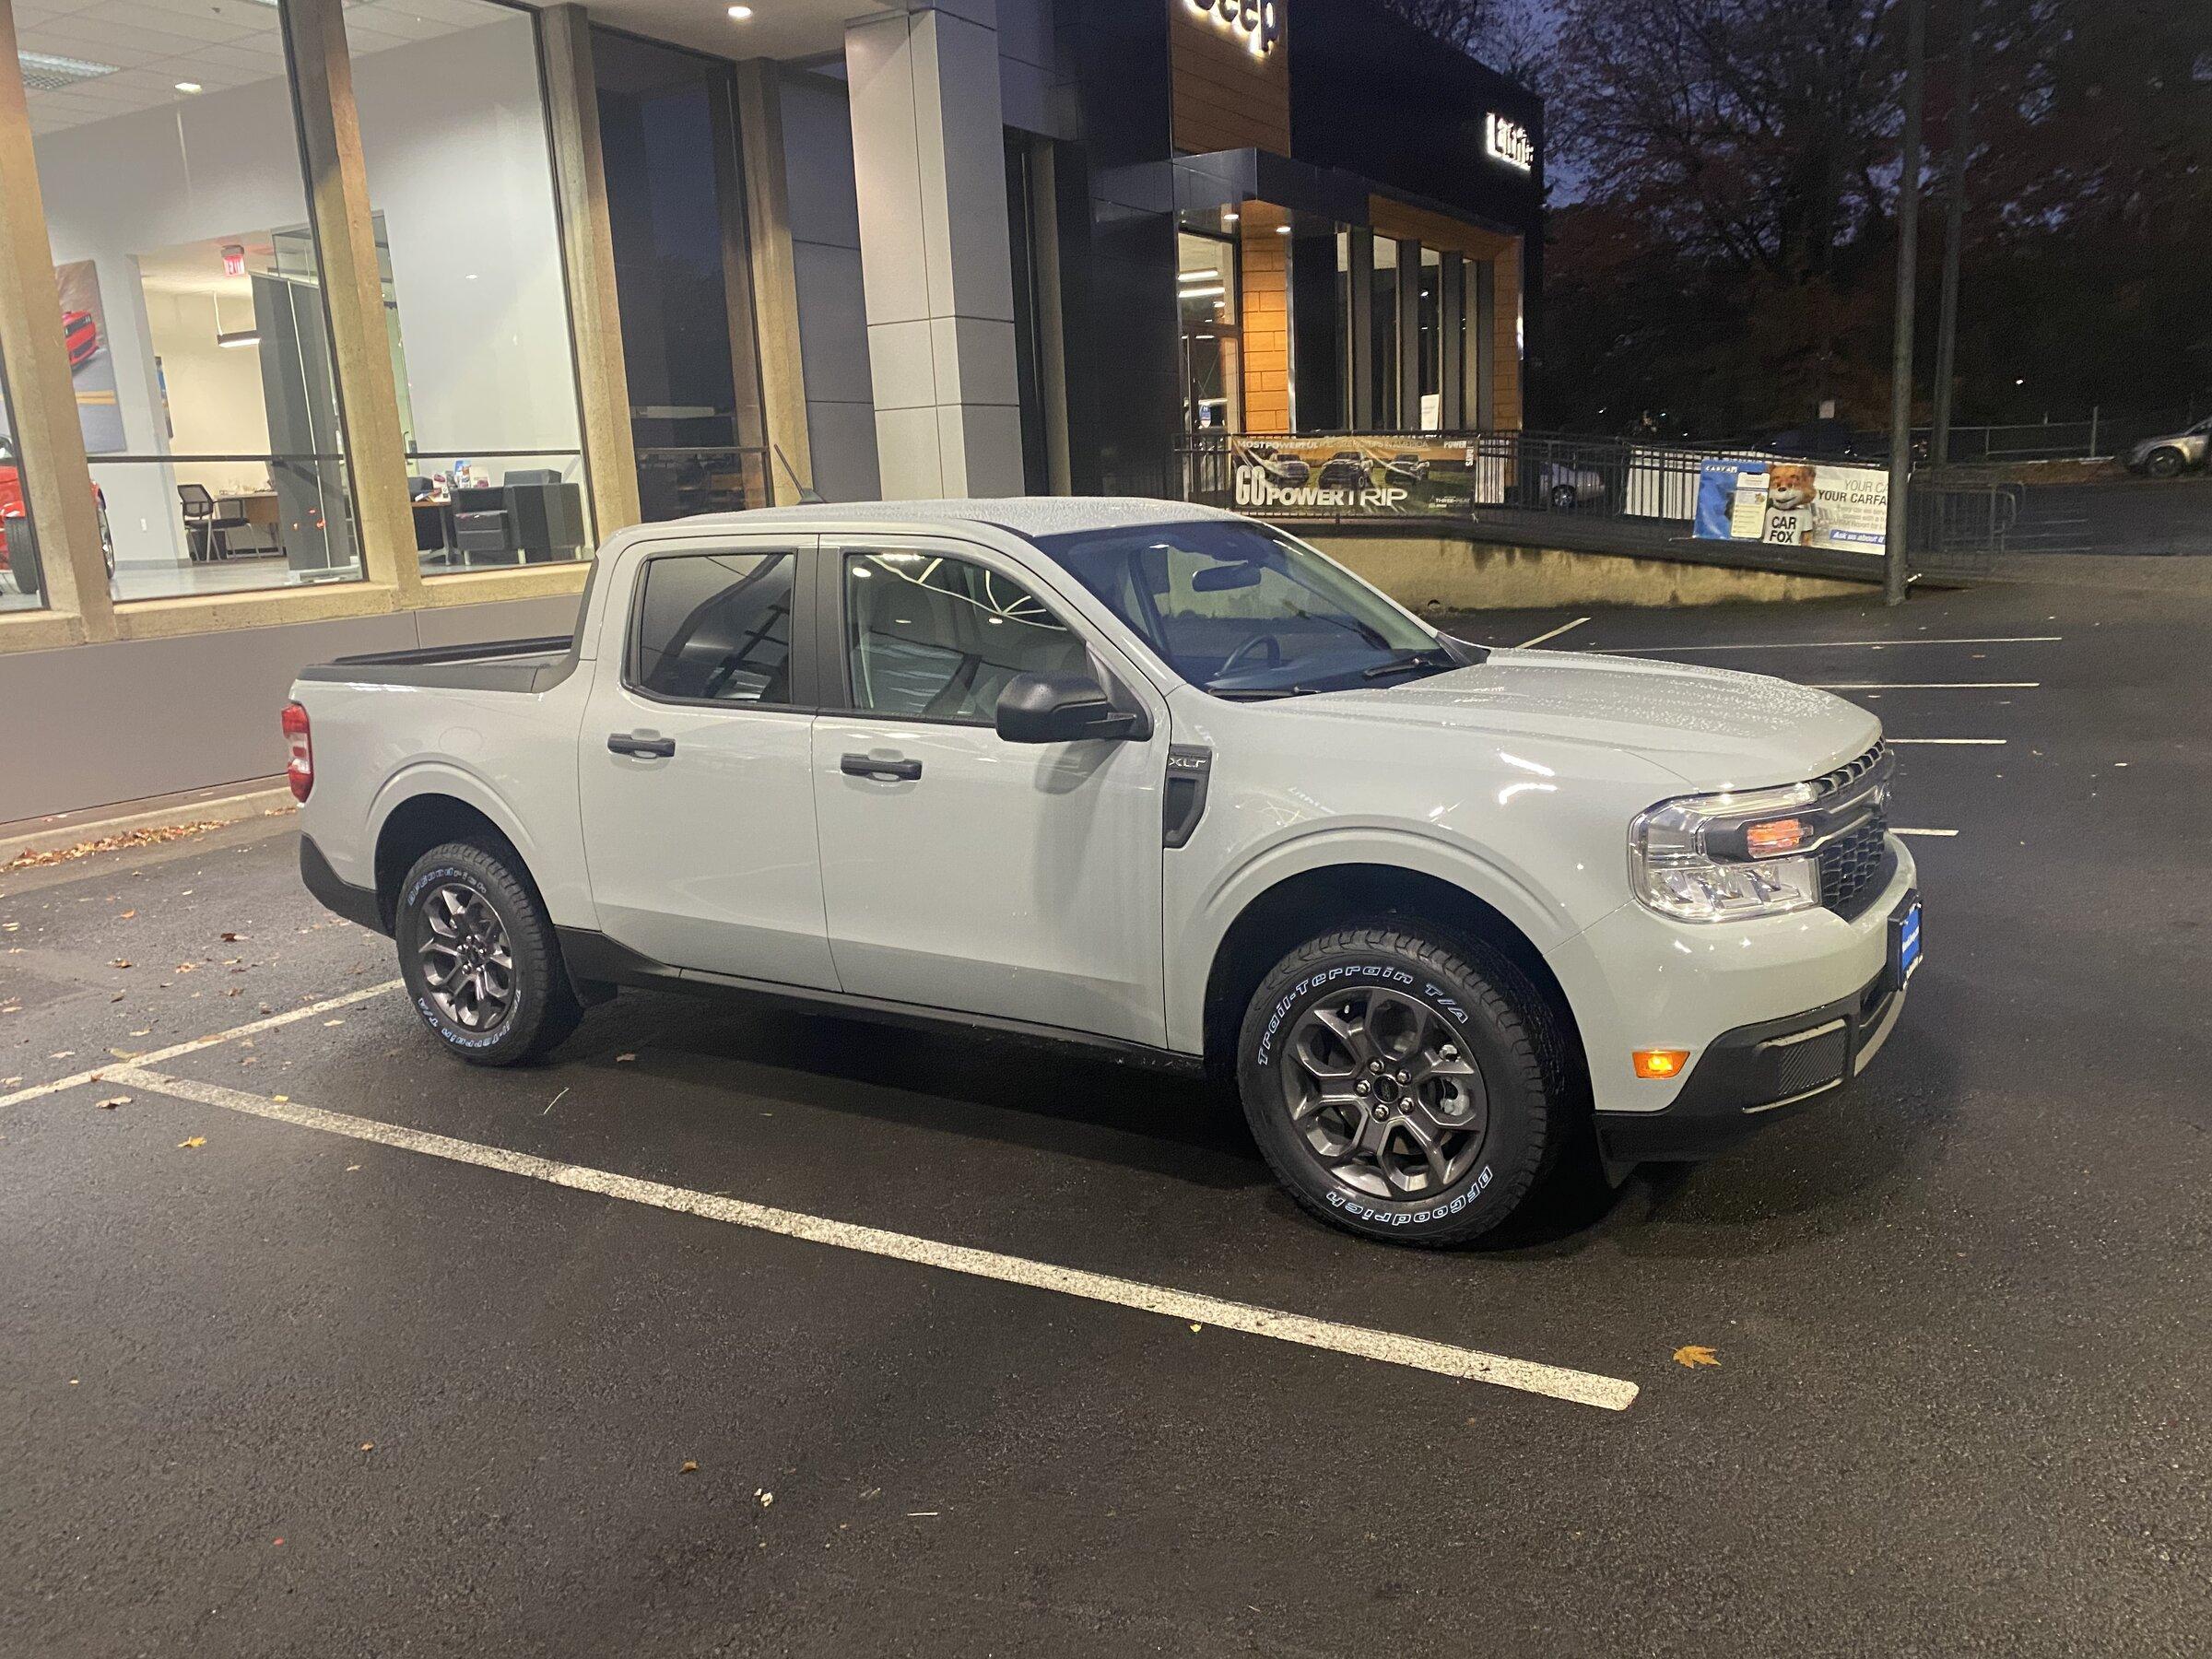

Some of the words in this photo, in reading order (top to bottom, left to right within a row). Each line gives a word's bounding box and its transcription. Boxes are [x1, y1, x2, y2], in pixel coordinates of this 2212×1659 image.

[1194, 0, 1280, 53] eep
[1845, 478, 1874, 492] YOUR
[1818, 489, 1847, 502] YOUR
[1771, 516, 1796, 529] CAR
[1770, 530, 1794, 543] FOX
[1325, 1164, 1493, 1227] BFGoodrich
